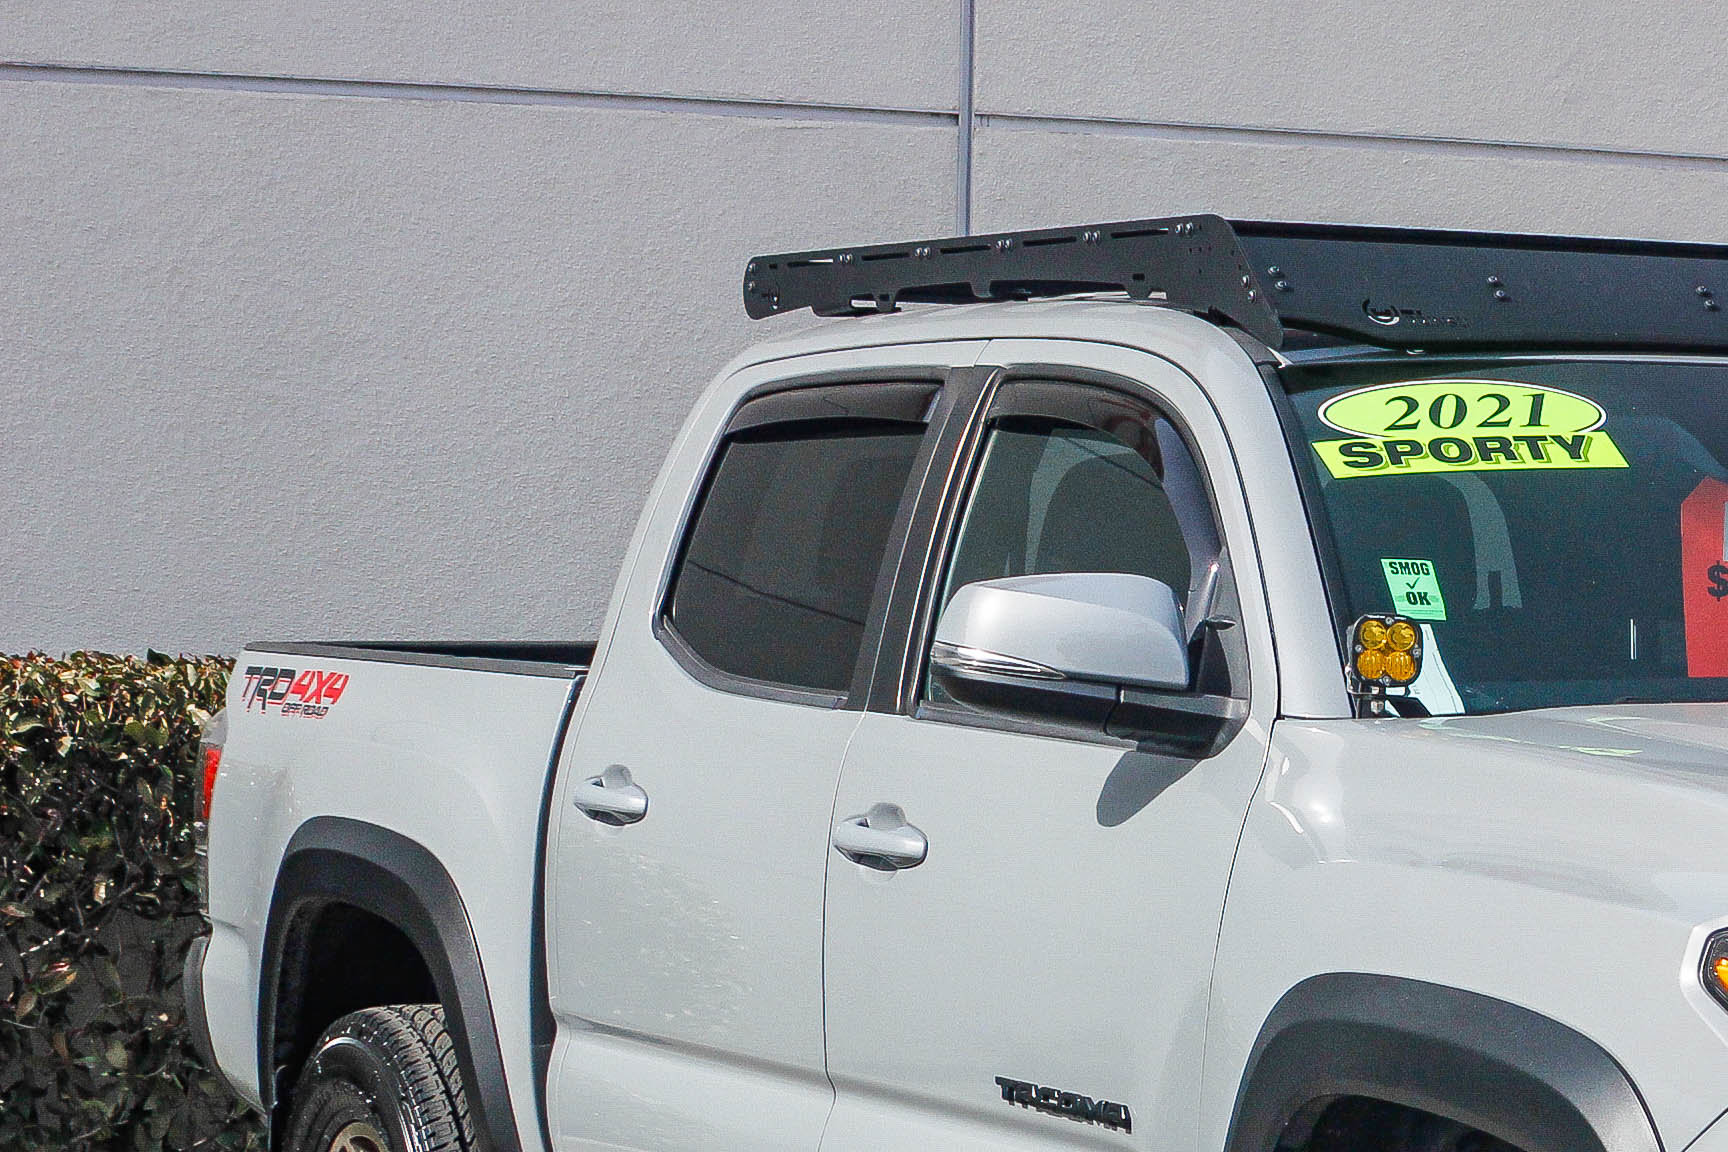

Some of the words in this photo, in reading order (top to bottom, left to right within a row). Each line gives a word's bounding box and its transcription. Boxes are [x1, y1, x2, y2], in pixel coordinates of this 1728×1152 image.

[1384, 393, 1549, 432] 2021
[1338, 435, 1590, 469] SPORTY
[1389, 562, 1431, 576] SMOG
[1406, 592, 1432, 606] OK
